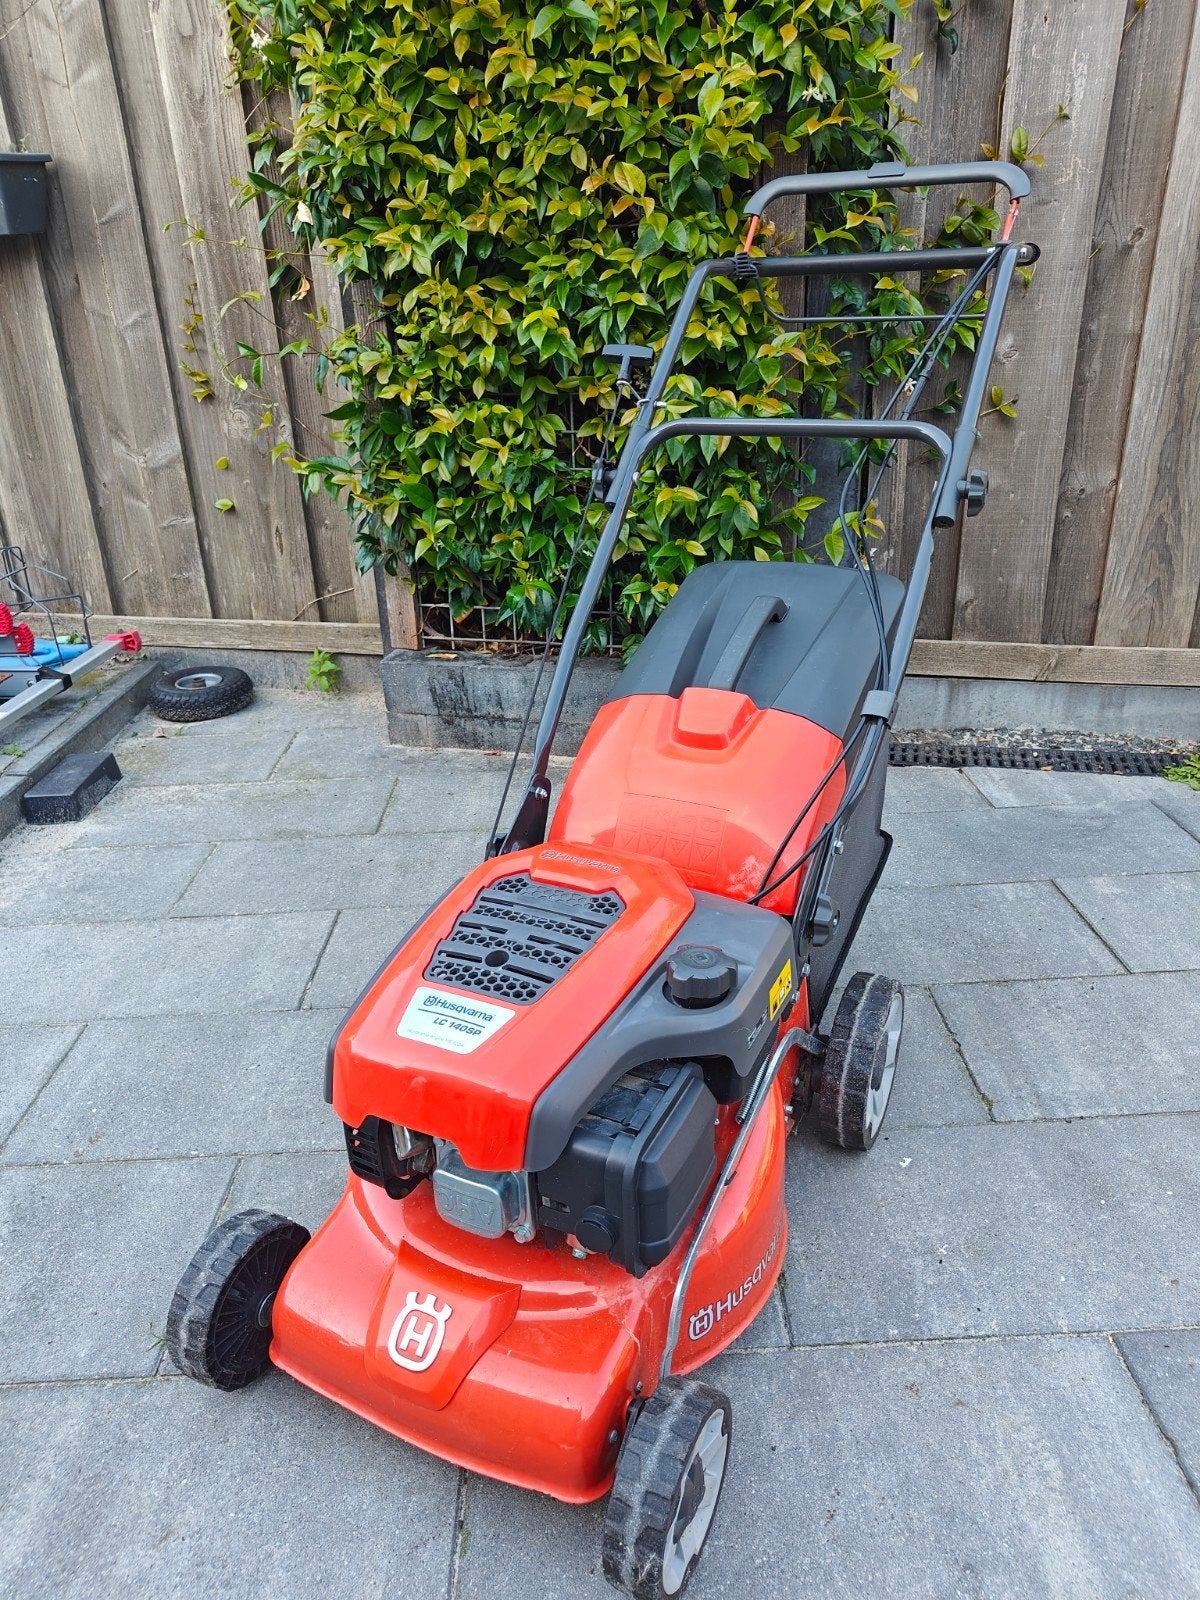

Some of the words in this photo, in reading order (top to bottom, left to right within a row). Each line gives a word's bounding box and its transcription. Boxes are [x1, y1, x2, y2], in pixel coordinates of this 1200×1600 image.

[435, 998, 494, 1022] Husqvarna
[433, 1017, 448, 1026] LC
[448, 1021, 482, 1036] 140SP
